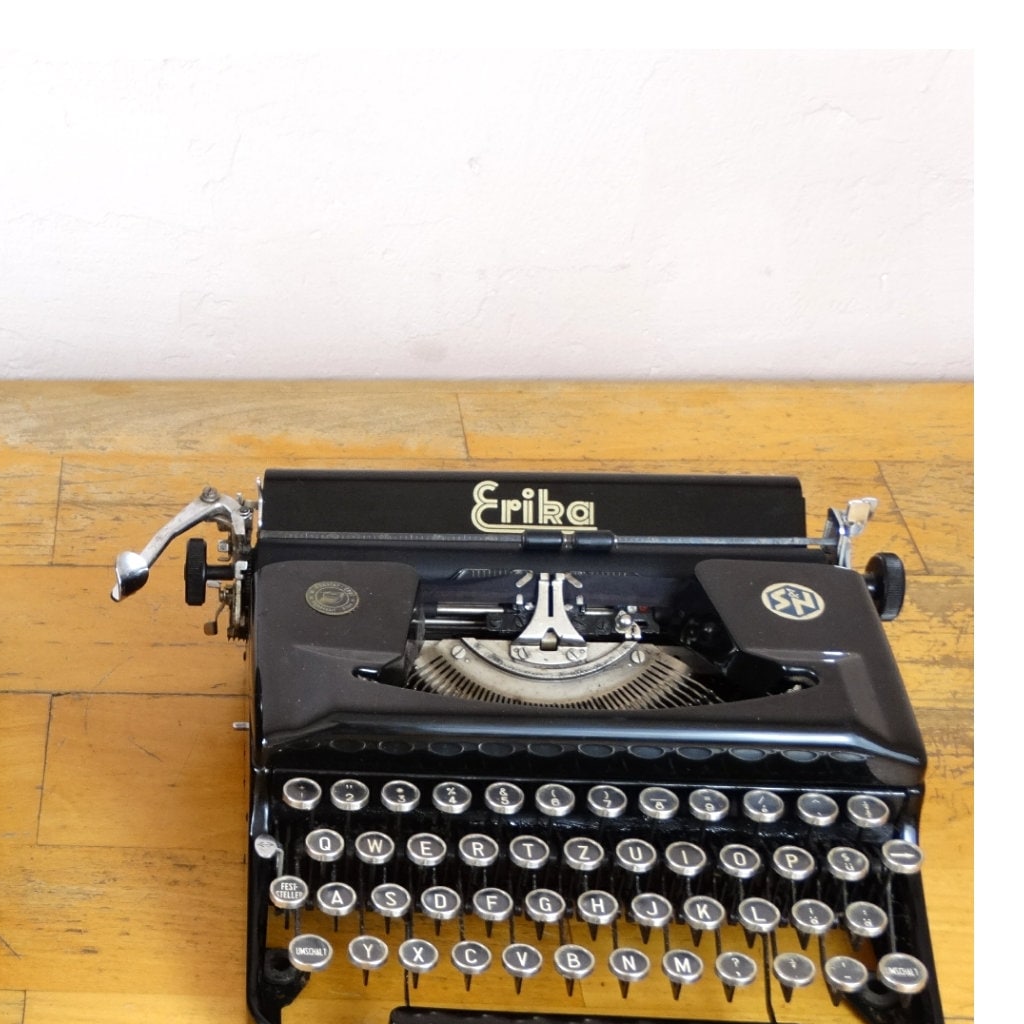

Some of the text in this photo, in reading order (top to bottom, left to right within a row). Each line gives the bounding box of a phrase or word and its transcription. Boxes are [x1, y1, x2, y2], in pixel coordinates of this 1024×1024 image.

[471, 480, 598, 533] Erika
[319, 836, 331, 851] Q
[367, 838, 383, 854] W
[420, 841, 433, 856] E
[471, 841, 485, 857] R
[522, 843, 534, 858] T
[577, 845, 591, 861] Z
[628, 846, 642, 861] U
[733, 852, 747, 866] O
[785, 854, 799, 869] P
[331, 890, 767, 922] A S D F G H J K L
[362, 943, 373, 959] Y
[413, 947, 425, 963] X
[464, 948, 477, 964] C
[516, 951, 527, 966] V
[567, 953, 580, 968] B
[622, 955, 636, 971] N
[674, 957, 691, 974] M
